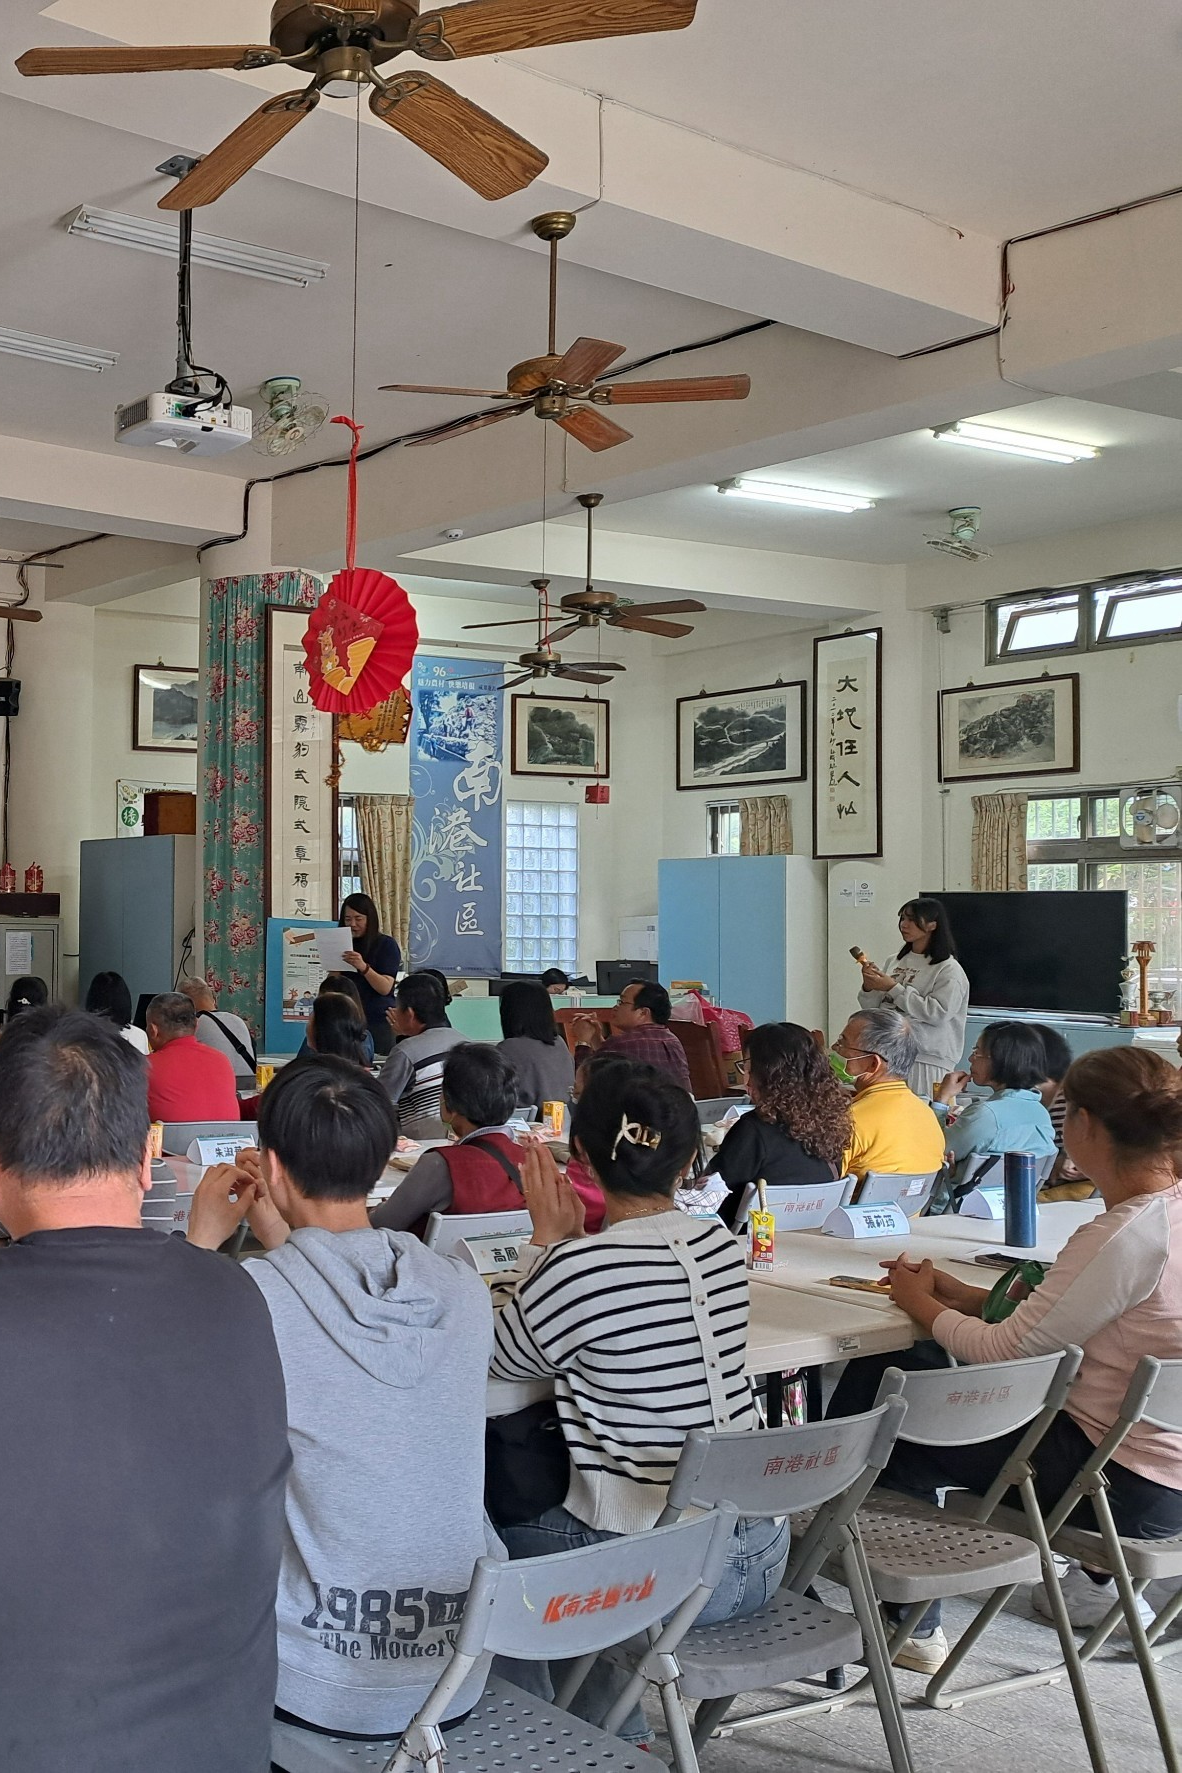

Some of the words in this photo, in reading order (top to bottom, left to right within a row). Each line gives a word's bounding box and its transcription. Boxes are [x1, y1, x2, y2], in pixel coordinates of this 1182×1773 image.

[429, 740, 502, 936] 南港社區
[784, 1199, 825, 1213] 南港社區
[946, 1384, 1013, 1405] 南港社區
[763, 1445, 841, 1476] 南港社區
[320, 1632, 362, 1660] The
